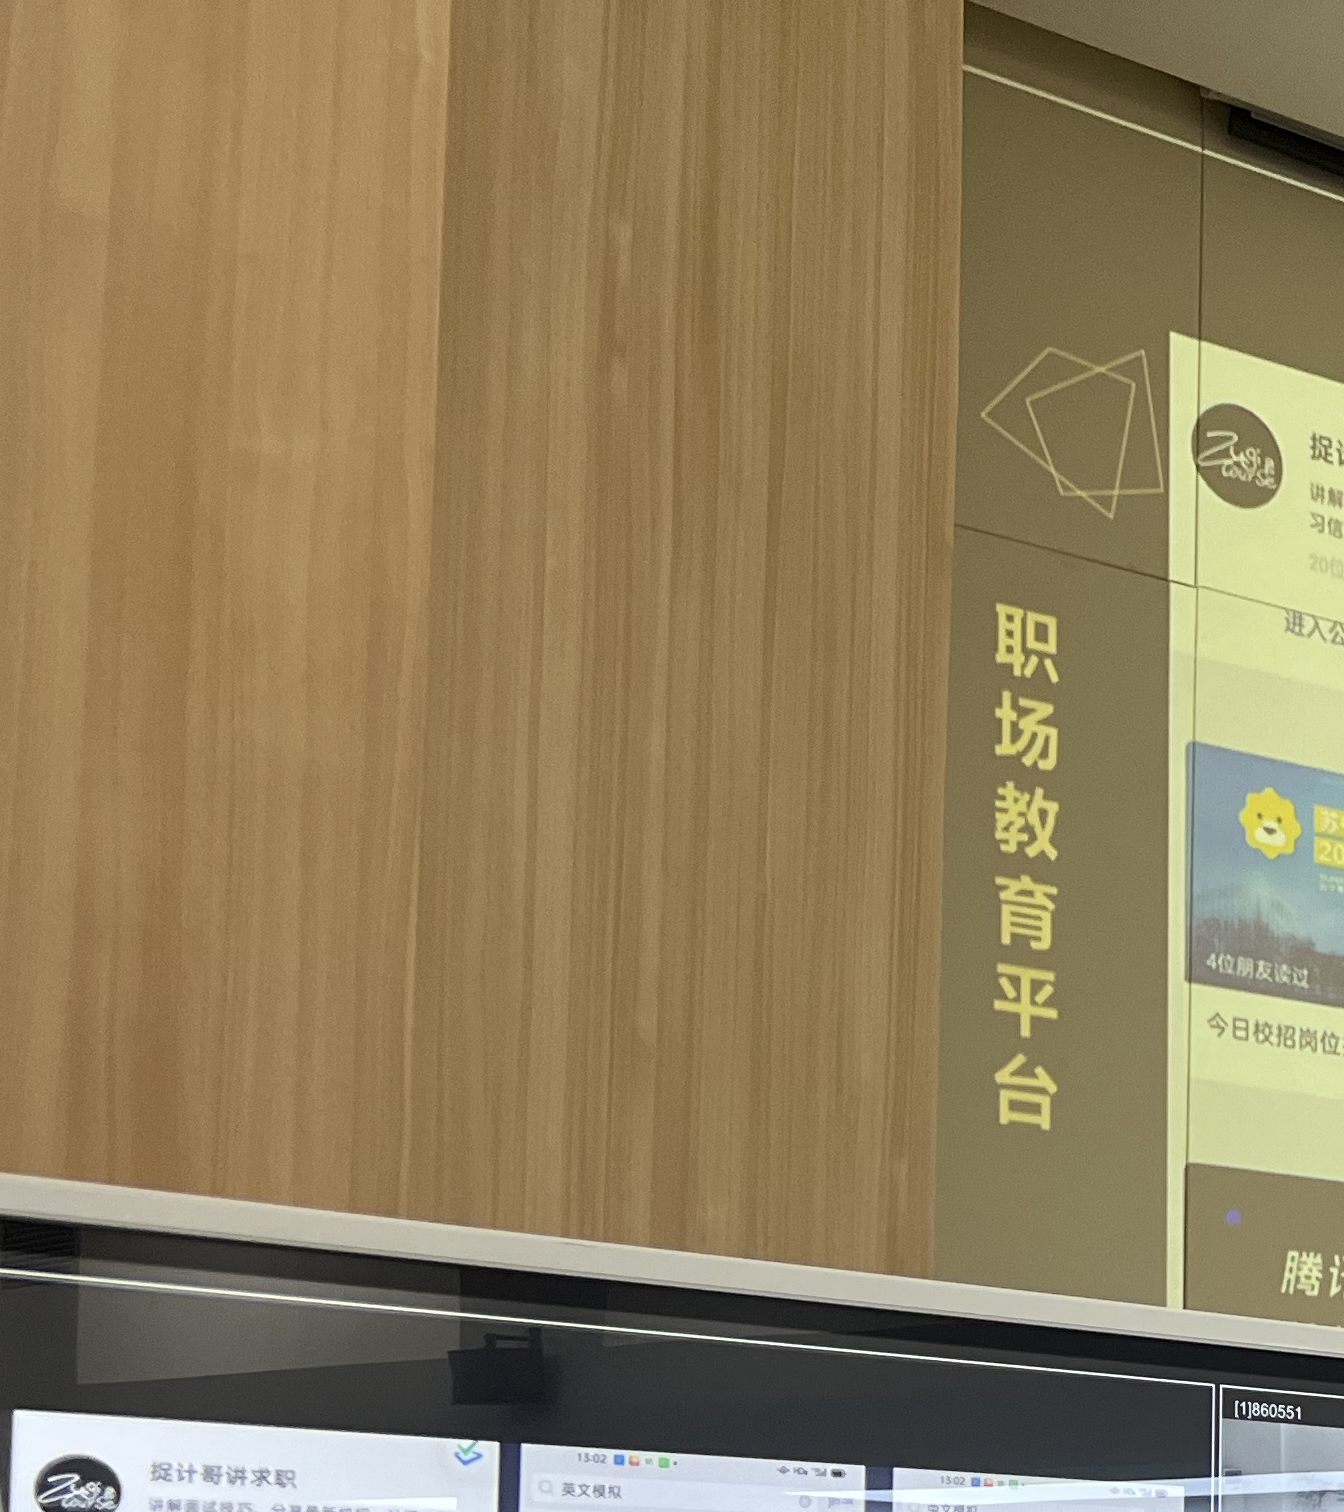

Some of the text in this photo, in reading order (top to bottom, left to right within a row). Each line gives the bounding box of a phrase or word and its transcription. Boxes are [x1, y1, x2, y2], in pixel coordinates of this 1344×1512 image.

[994, 602, 1059, 1131] 职场教育平台
[1234, 1400, 1302, 1421] [1]860551
[150, 1462, 297, 1489] 捉计哥讲求职
[561, 1482, 623, 1500] 英文模拟
